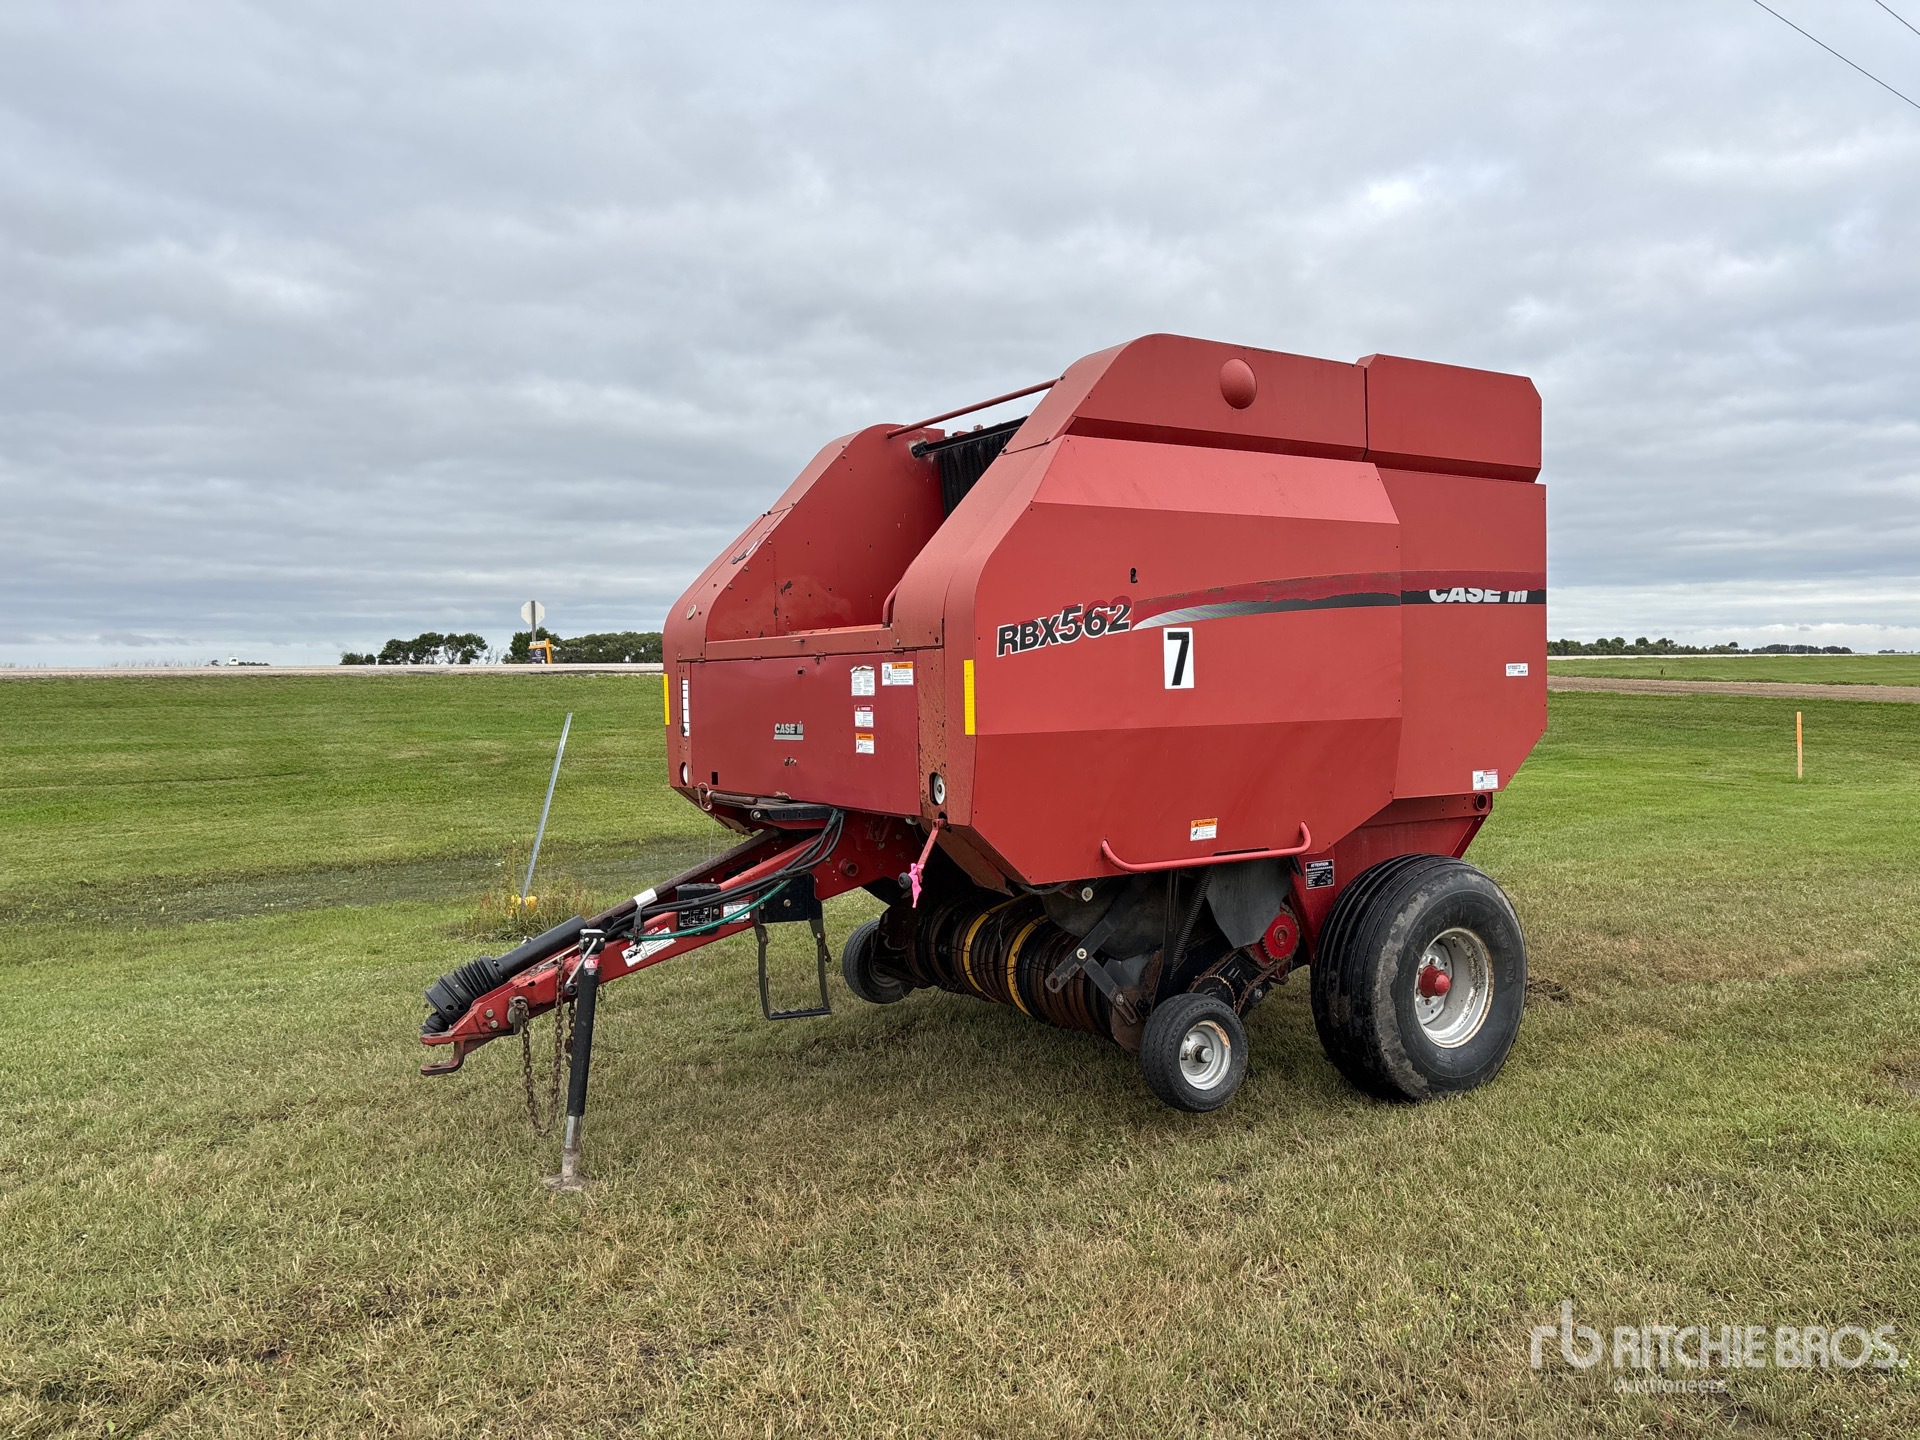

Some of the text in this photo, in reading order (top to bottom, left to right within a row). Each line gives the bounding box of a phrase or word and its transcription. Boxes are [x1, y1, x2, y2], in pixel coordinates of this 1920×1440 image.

[1429, 587, 1501, 603] CASE
[996, 603, 1132, 657] RBX562
[1167, 632, 1190, 686] 7
[774, 723, 796, 735] CASE
